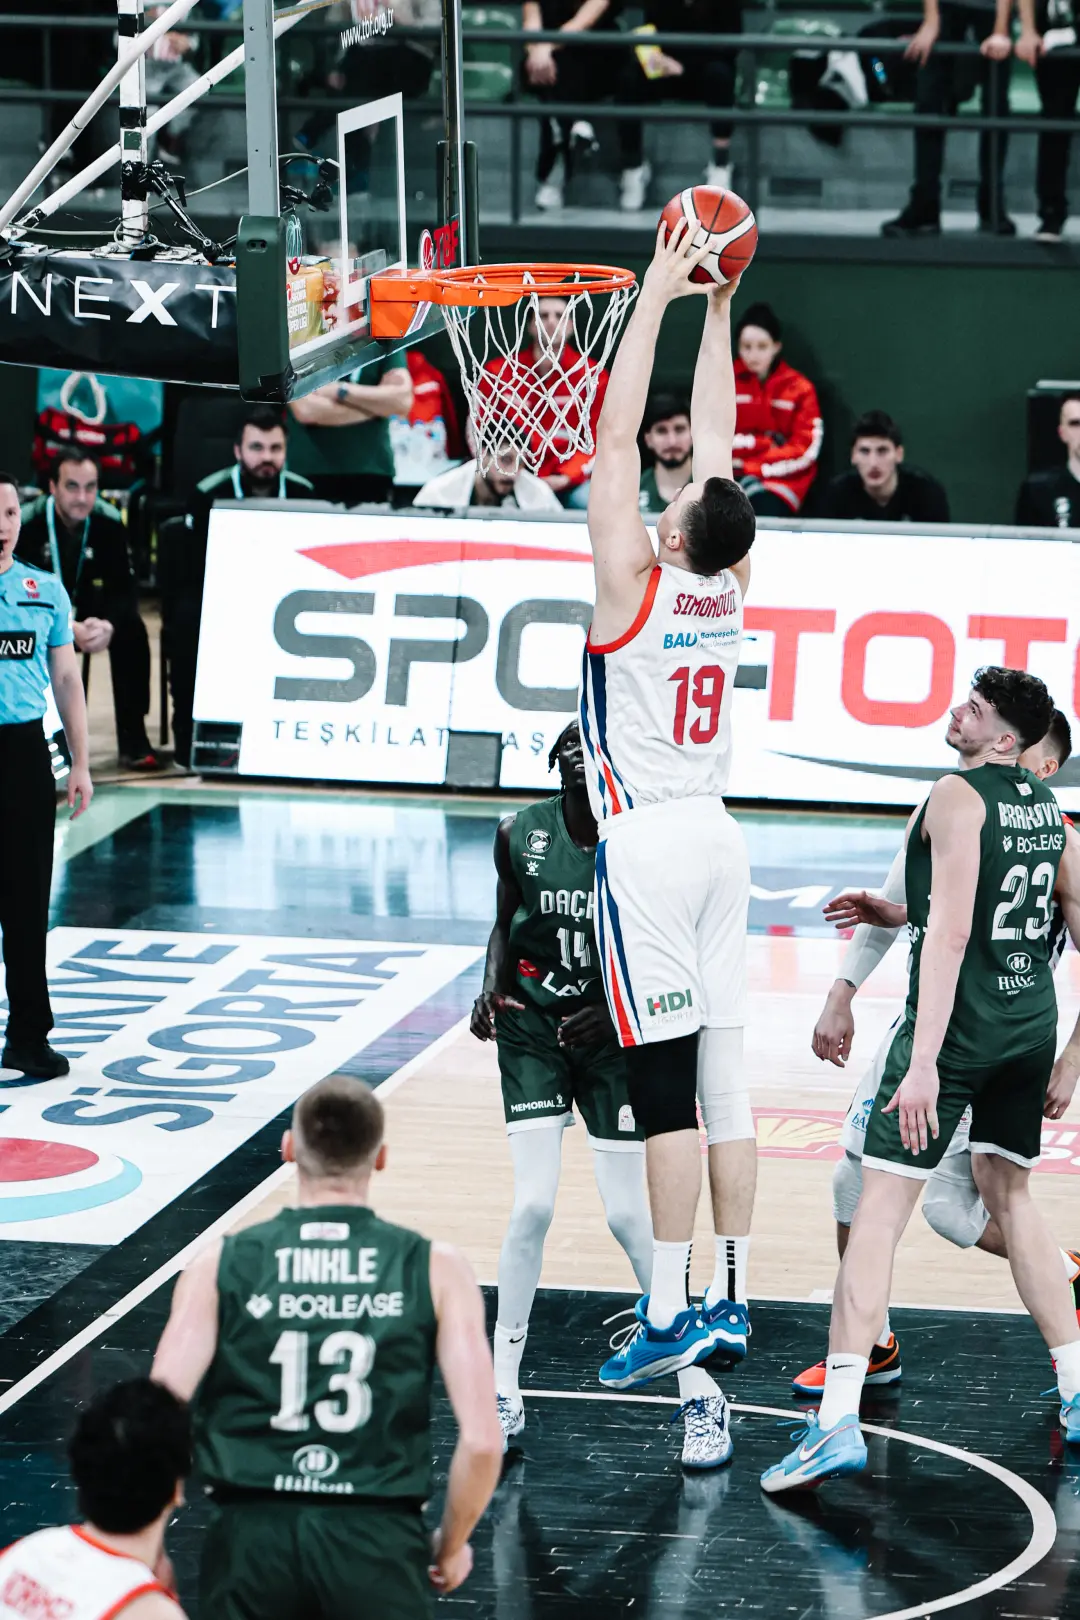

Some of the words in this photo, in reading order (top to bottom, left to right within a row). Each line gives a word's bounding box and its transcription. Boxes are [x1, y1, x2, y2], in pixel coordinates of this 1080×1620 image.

[340, 7, 394, 50] www.tbf.org.tr
[433, 219, 459, 269] TBF
[11, 270, 237, 329] NEXT
[273, 589, 595, 713] SPO
[743, 606, 1080, 728] TOT
[663, 633, 698, 649] BAU
[667, 665, 726, 745] 19
[273, 720, 449, 747] TEŞKİLAT
[991, 862, 1054, 941] 23
[556, 927, 592, 972] 14
[646, 988, 693, 1017] HDI
[510, 1100, 556, 1113] MEMORIAL
[274, 1247, 378, 1284] TINKLE
[278, 1291, 404, 1319] BORLEASE
[268, 1330, 377, 1433] 13
